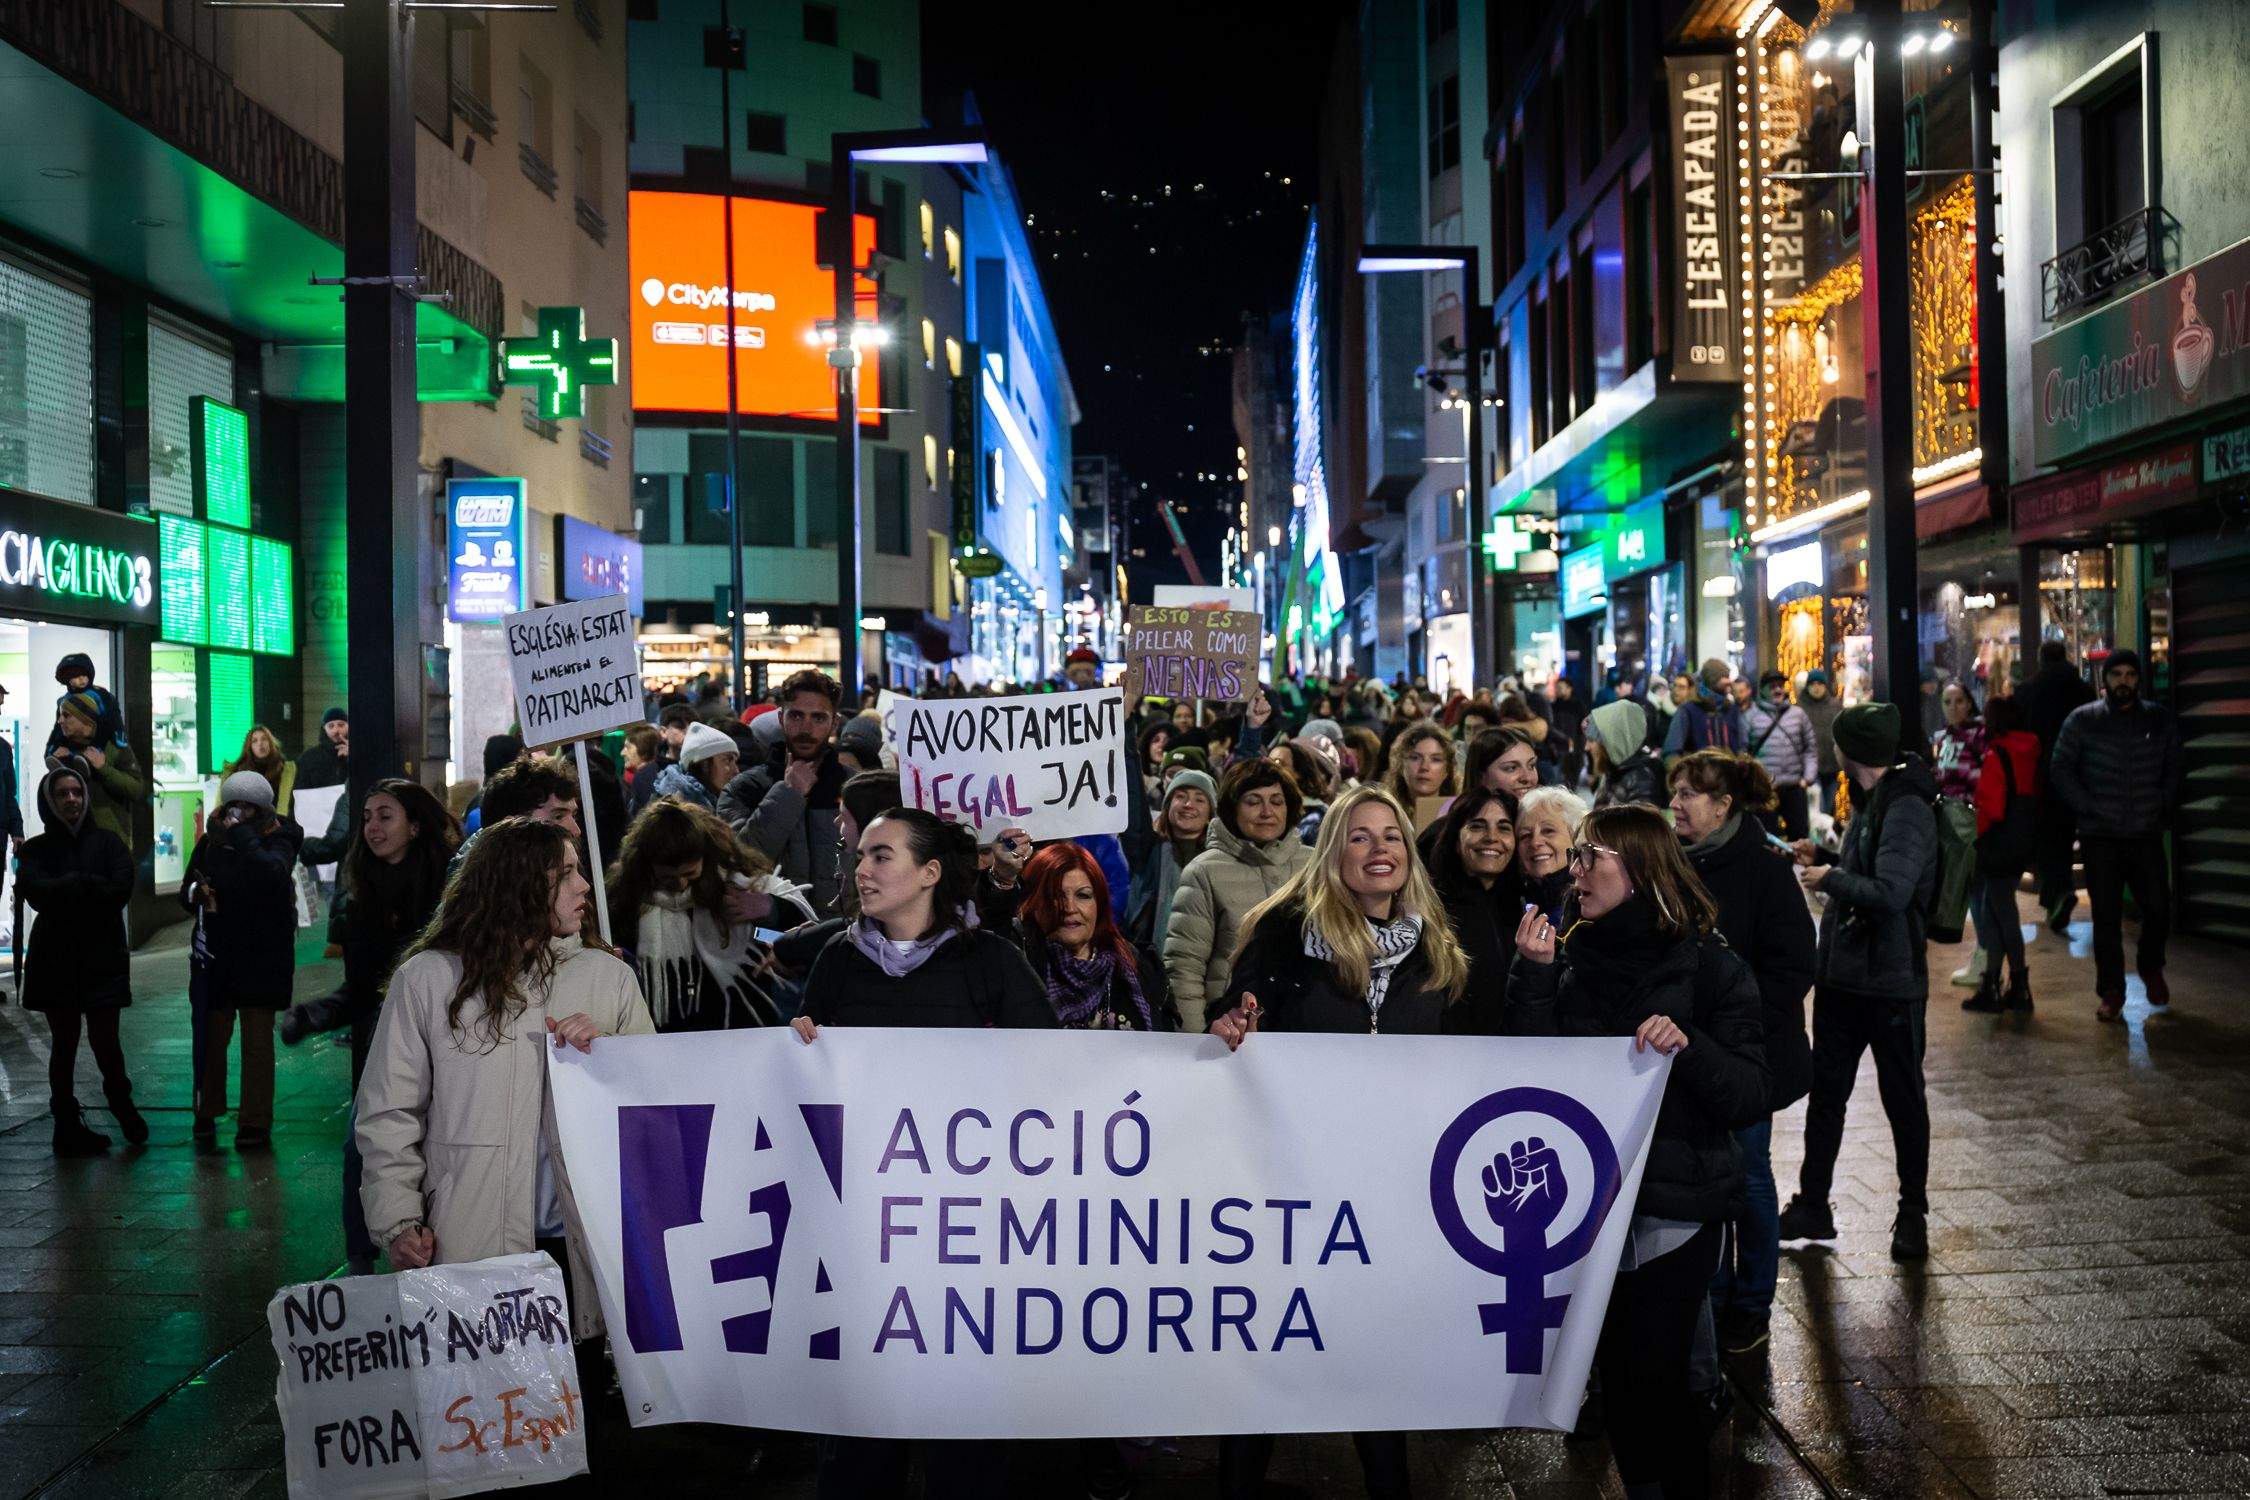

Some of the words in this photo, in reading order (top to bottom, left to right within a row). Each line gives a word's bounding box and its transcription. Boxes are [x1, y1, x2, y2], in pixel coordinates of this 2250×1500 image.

[2043, 330, 2160, 432] Cafeteria
[581, 609, 627, 643] ESTAT
[1135, 629, 1194, 651] PELEAR
[1207, 630, 1247, 655] COMO
[1144, 608, 1190, 625] ESTO
[1206, 611, 1234, 629] ES
[525, 673, 636, 727] PATRIARCAT
[531, 657, 592, 685] ALIMENTEN
[907, 696, 1122, 760] AVORTAMENT
[1041, 749, 1118, 811] JA!
[877, 1089, 1151, 1177] ACCIÓ
[880, 1196, 1371, 1265] FEMINISTA
[283, 1283, 346, 1338] NO
[447, 1286, 569, 1363] AVORTAR
[872, 1286, 1325, 1355] ANDORRA
[314, 1409, 422, 1469] FORA
